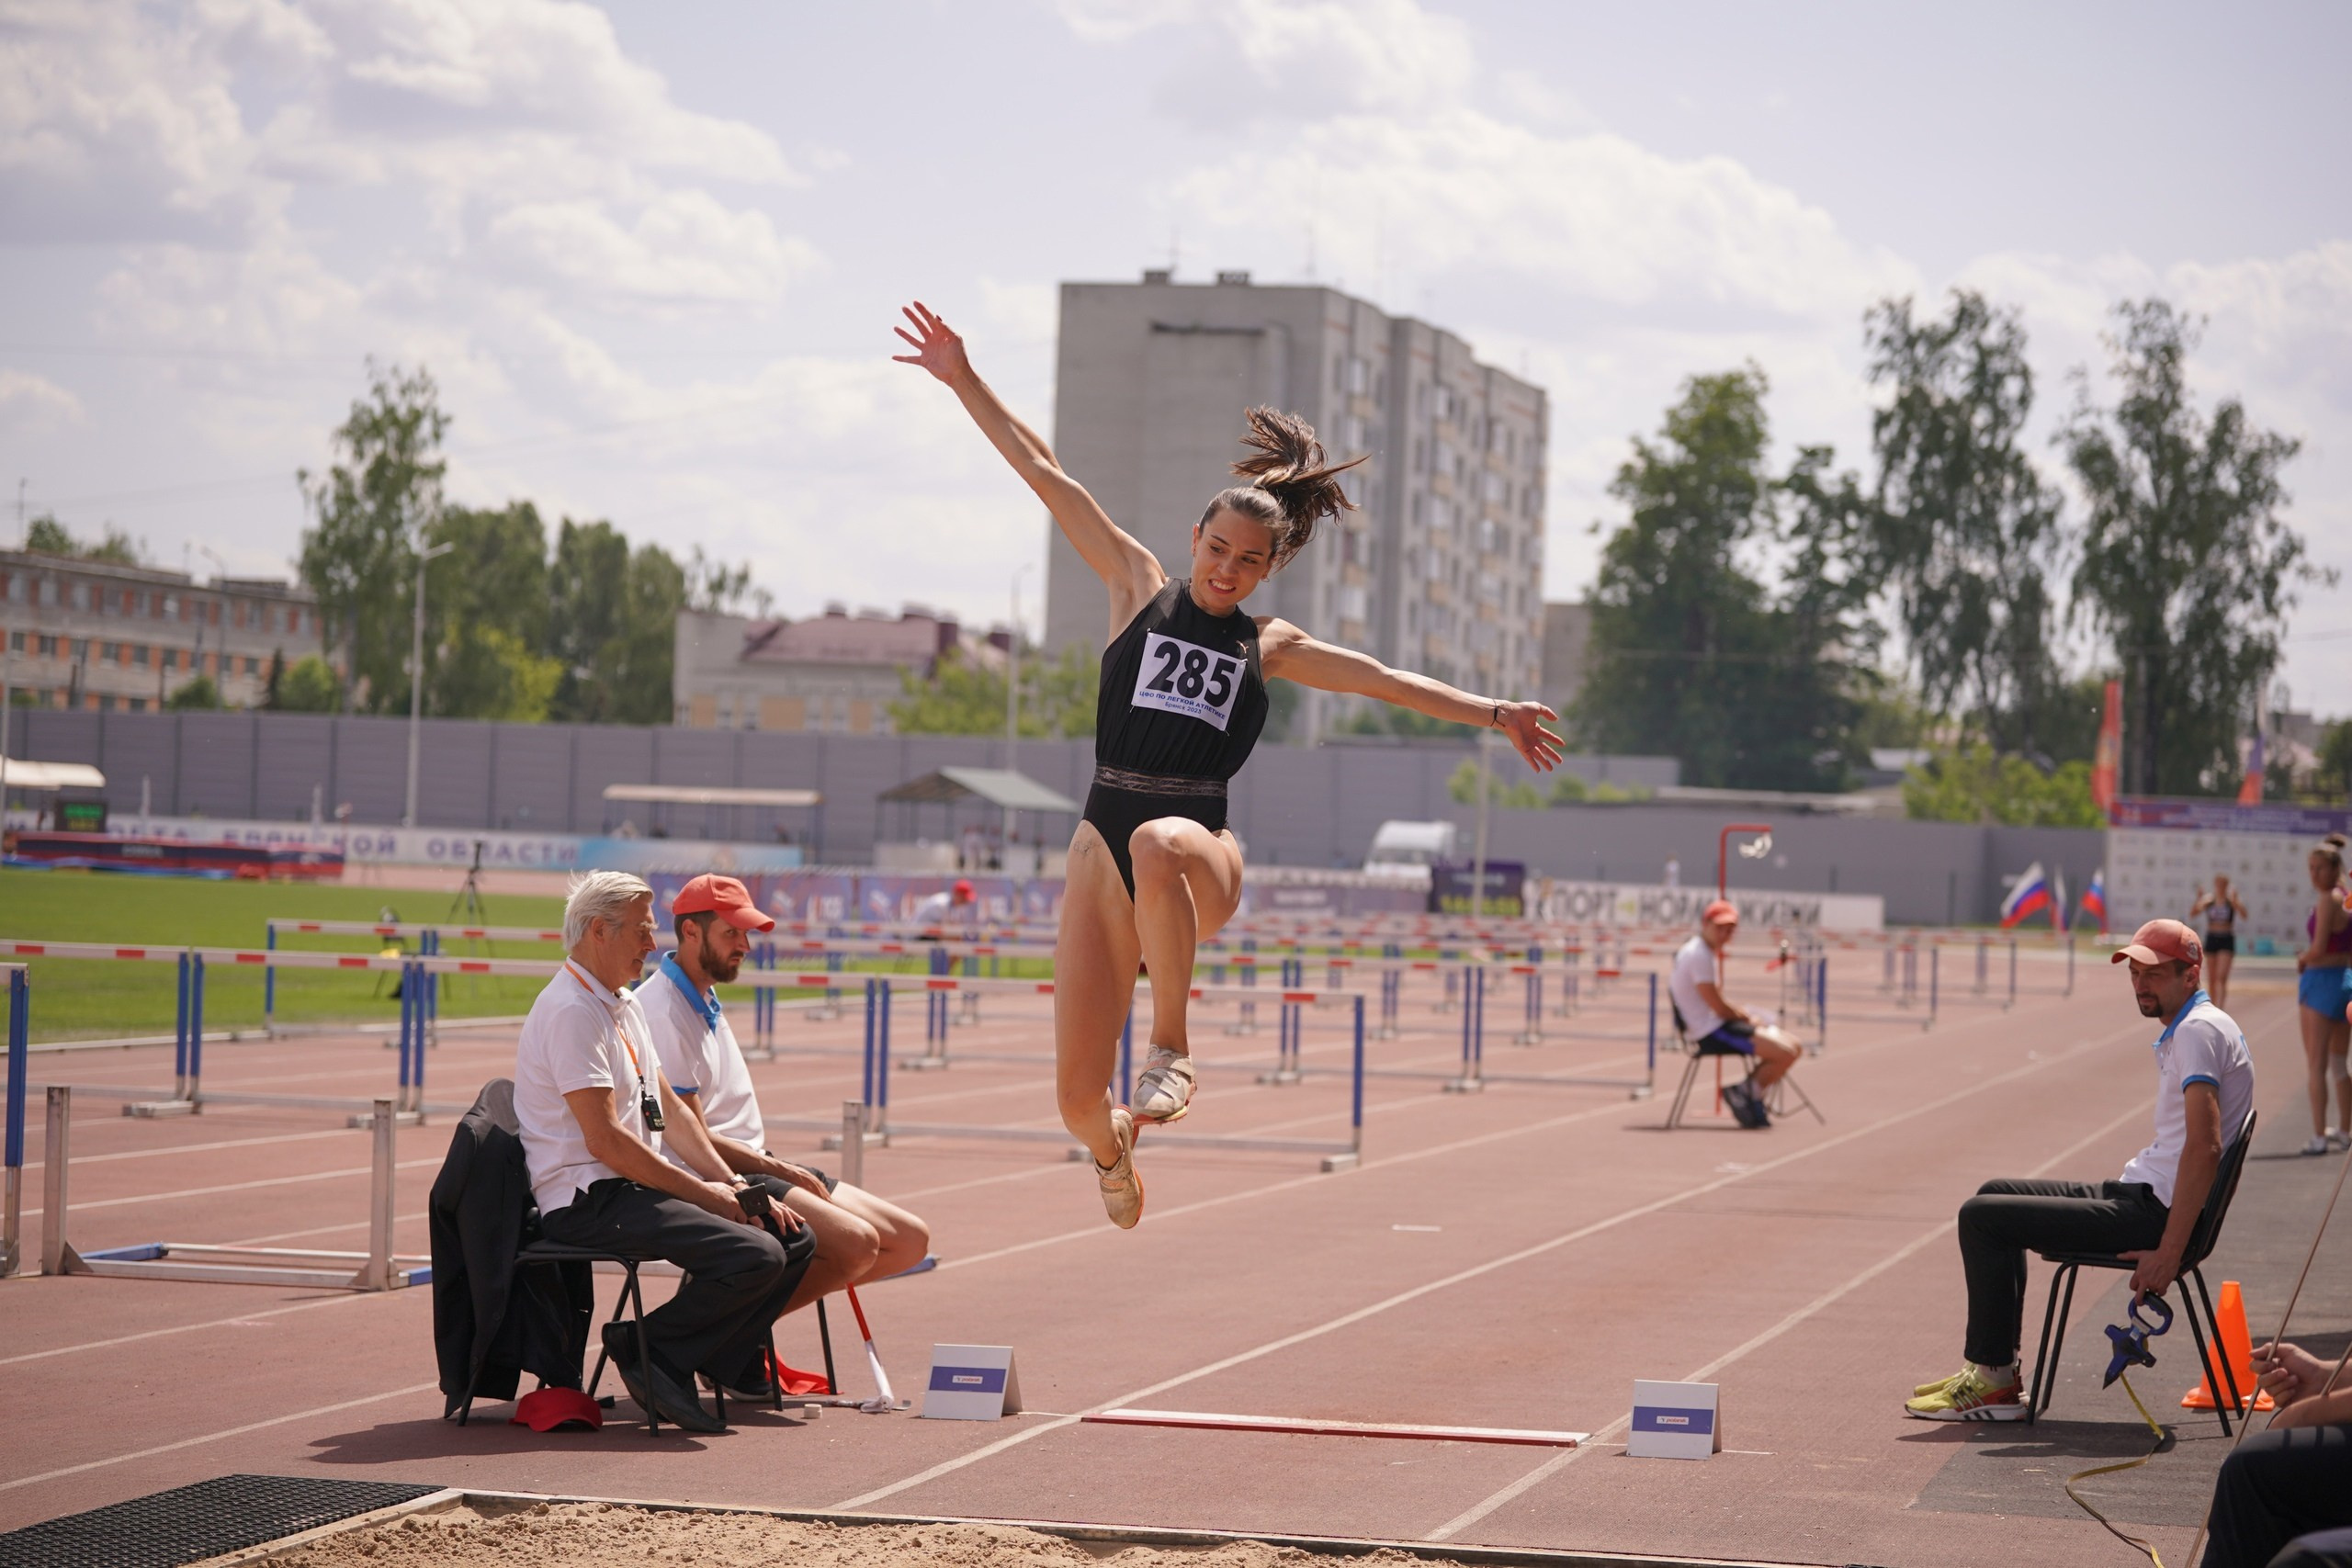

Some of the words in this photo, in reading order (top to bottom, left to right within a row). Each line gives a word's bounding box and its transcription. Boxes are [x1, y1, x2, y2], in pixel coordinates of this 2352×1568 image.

[1146, 641, 1237, 707] 285
[1165, 701, 1185, 710] Брянск
[1167, 695, 1194, 705] ЛЕГКОЙ
[1195, 703, 1226, 720] АТЛЕТИКЕ
